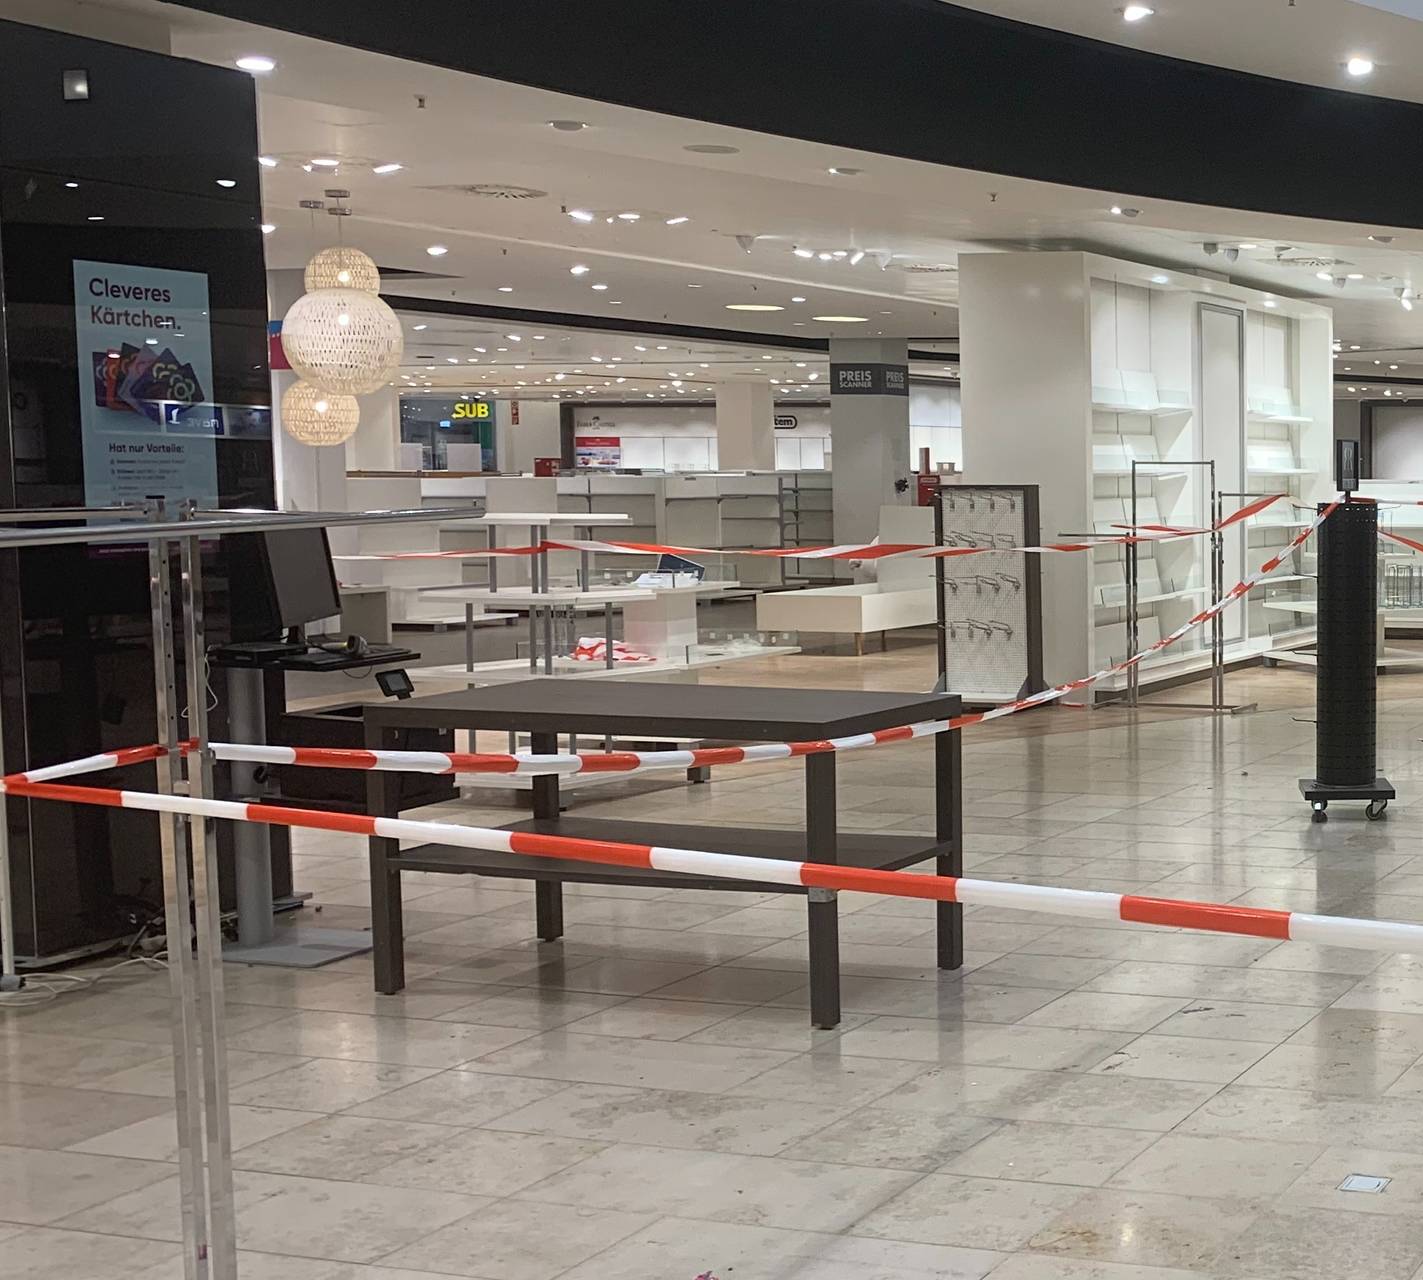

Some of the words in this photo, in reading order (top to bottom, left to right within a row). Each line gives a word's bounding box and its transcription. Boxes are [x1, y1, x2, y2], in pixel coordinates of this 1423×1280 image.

[89, 277, 171, 303] Cleveres
[91, 304, 182, 330] Kärtchen.
[839, 370, 872, 381] PREIS
[109, 443, 126, 453] Hat
[129, 445, 144, 453] nur
[147, 443, 184, 453] Vorteile:
